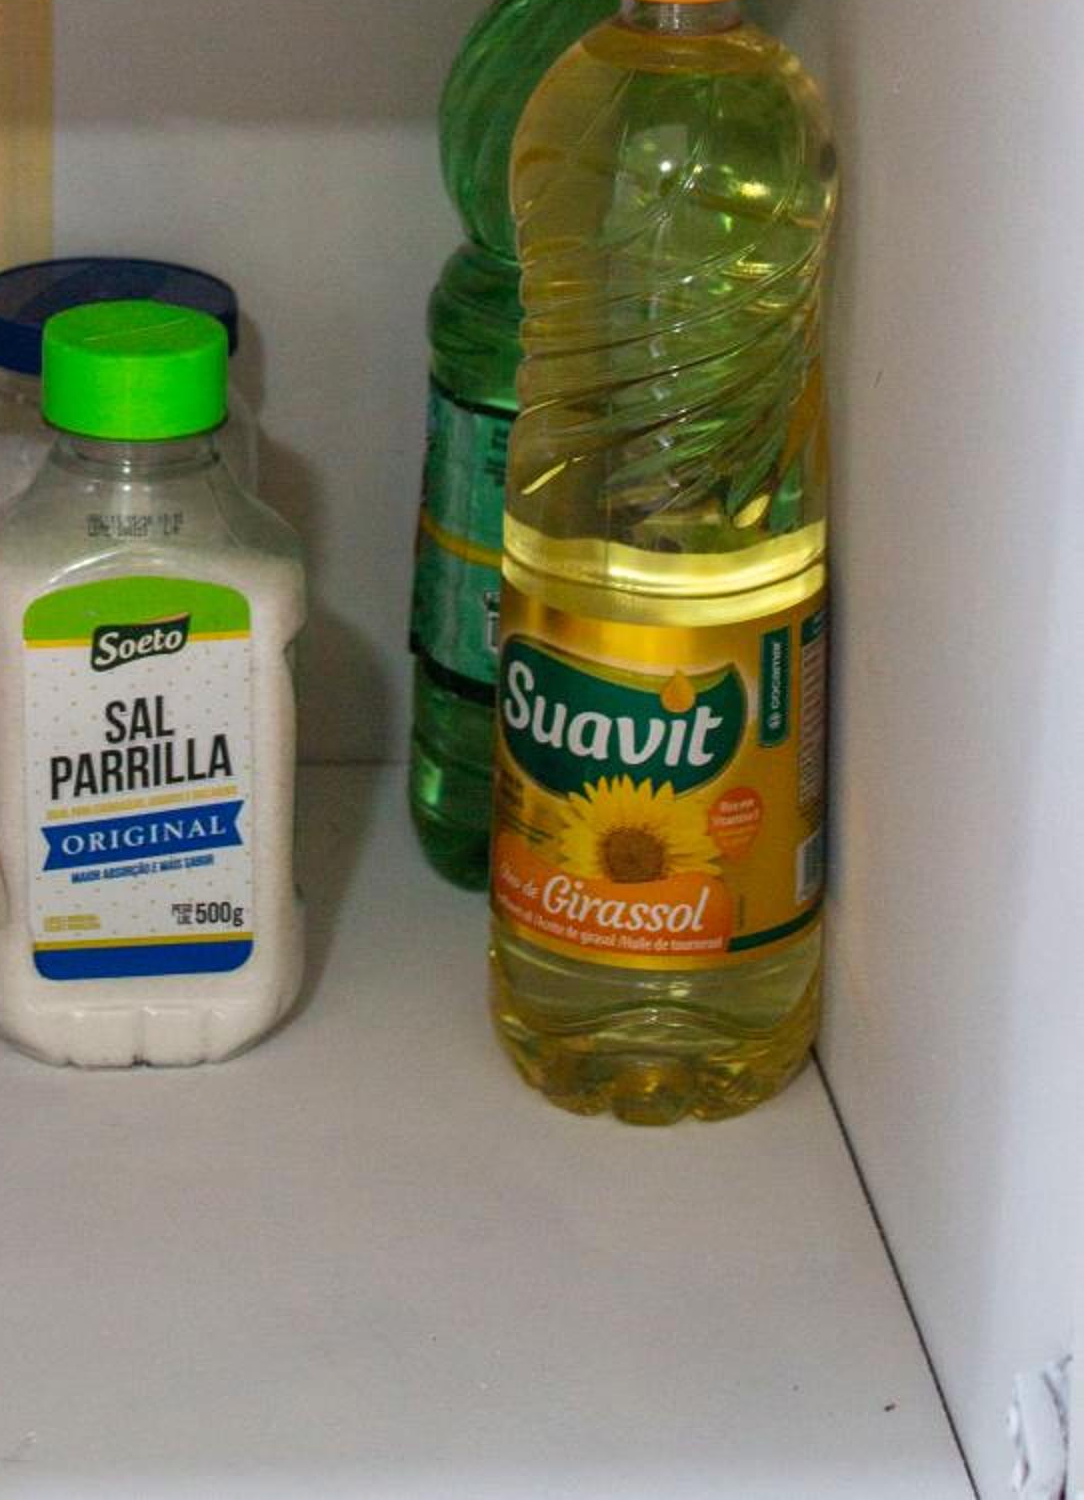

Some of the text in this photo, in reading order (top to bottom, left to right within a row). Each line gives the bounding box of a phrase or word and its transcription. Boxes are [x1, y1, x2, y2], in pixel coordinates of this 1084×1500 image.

[93, 627, 183, 666] Soeto
[104, 695, 175, 744] SAL
[502, 658, 724, 767] Suavit
[50, 733, 233, 801] PARRILLA
[61, 814, 227, 857] ORIGINAL
[195, 901, 245, 927] 500g
[542, 874, 711, 933] Girassol
